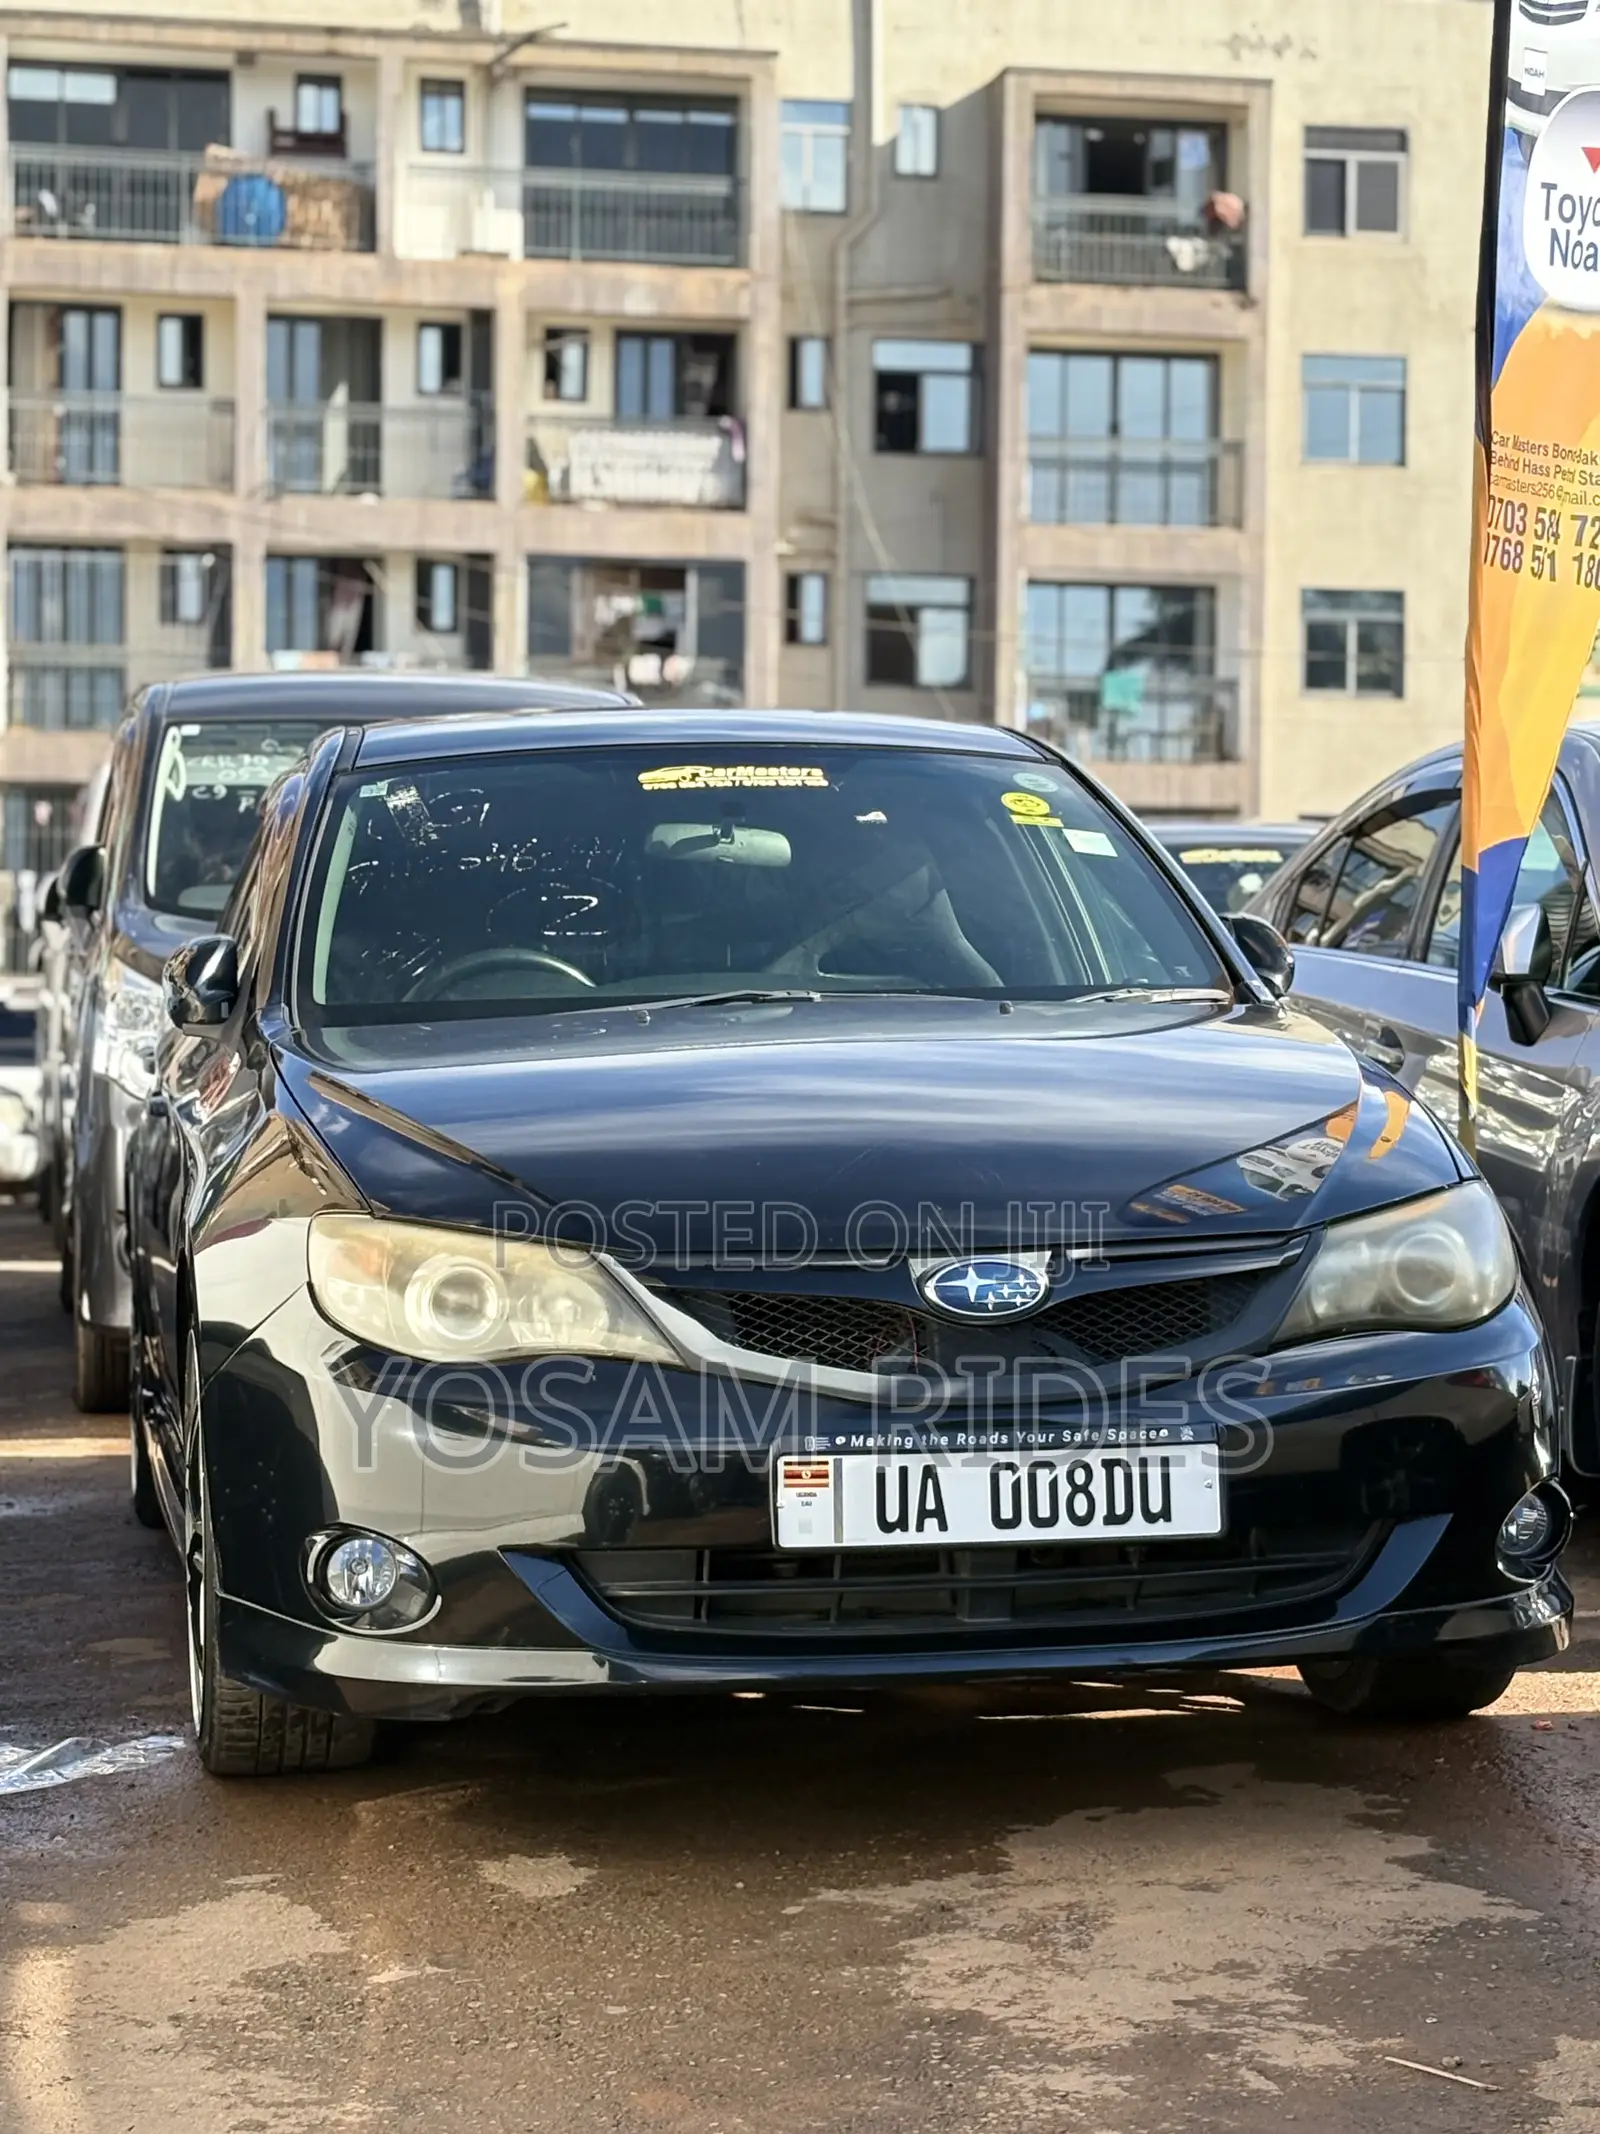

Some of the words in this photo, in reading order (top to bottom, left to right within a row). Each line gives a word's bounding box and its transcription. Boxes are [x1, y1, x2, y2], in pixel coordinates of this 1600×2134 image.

[1492, 430, 1511, 448] Car
[1523, 458, 1551, 477] Hass
[1570, 514, 1600, 550] 72
[850, 1434, 914, 1449] Making
[921, 1433, 949, 1446] the
[956, 1431, 1009, 1446] Roads
[1016, 1431, 1055, 1444] Your
[1062, 1429, 1100, 1442] Safe
[1107, 1428, 1157, 1443] Space
[876, 1463, 949, 1534] UA
[989, 1456, 1173, 1530] 008DU
